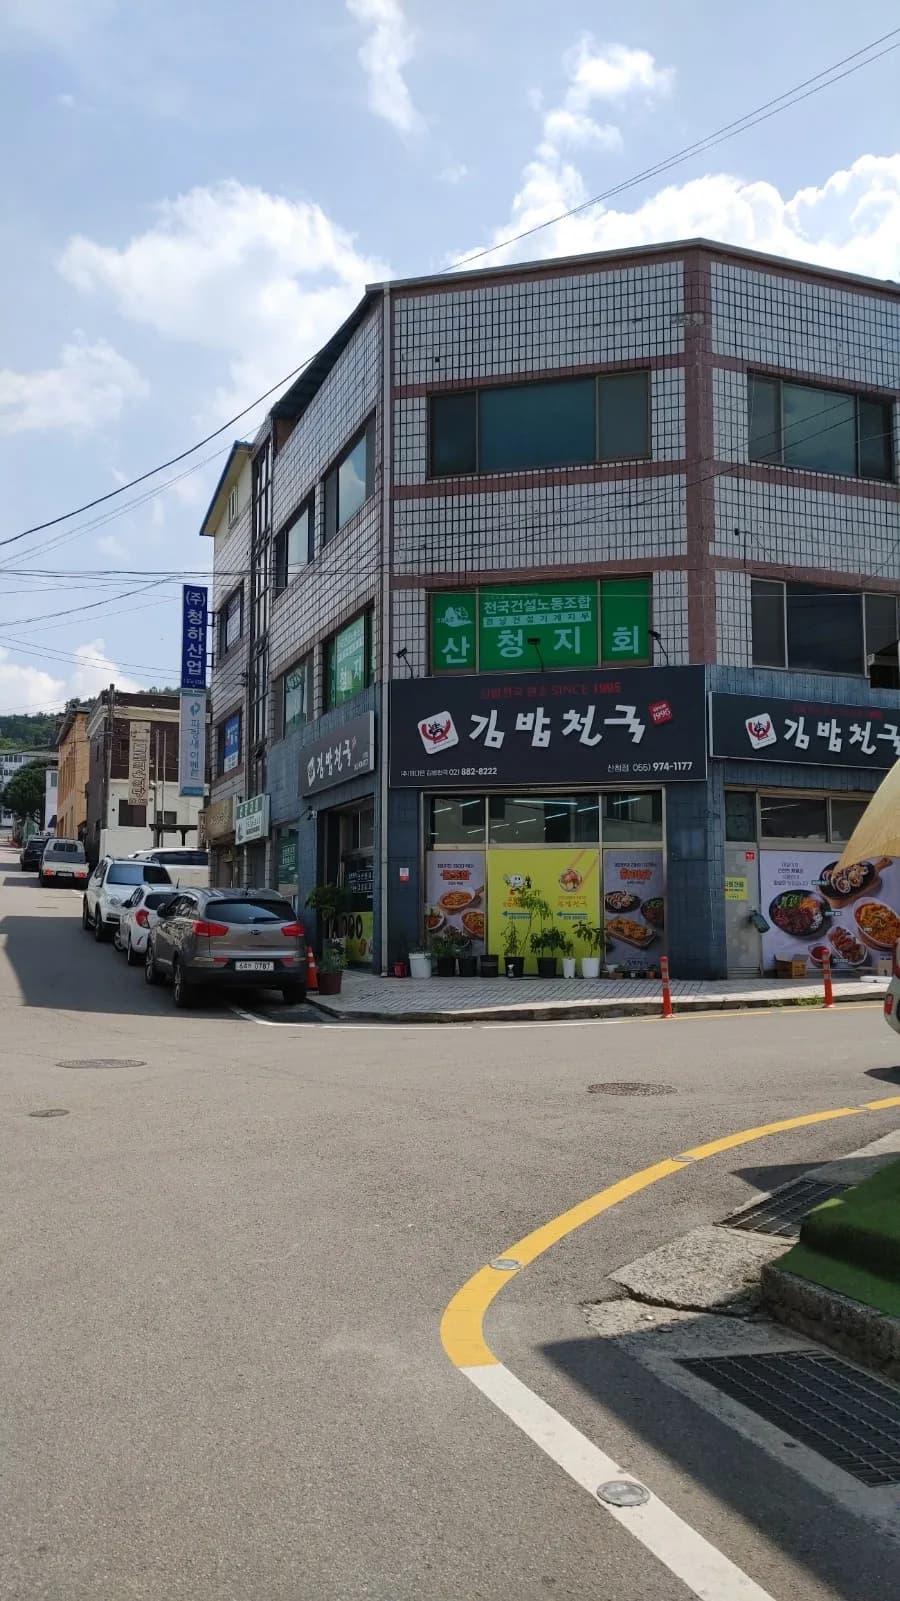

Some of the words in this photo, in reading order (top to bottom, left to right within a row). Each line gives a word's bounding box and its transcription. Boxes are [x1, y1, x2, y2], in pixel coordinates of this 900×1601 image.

[484, 595, 591, 614] 전국건설노동조합
[551, 684, 590, 697] SINCE
[469, 705, 646, 749] 김밥천국
[317, 739, 351, 779] 김밥천국
[652, 761, 692, 771] 974-1177
[461, 767, 498, 776] 882-8222
